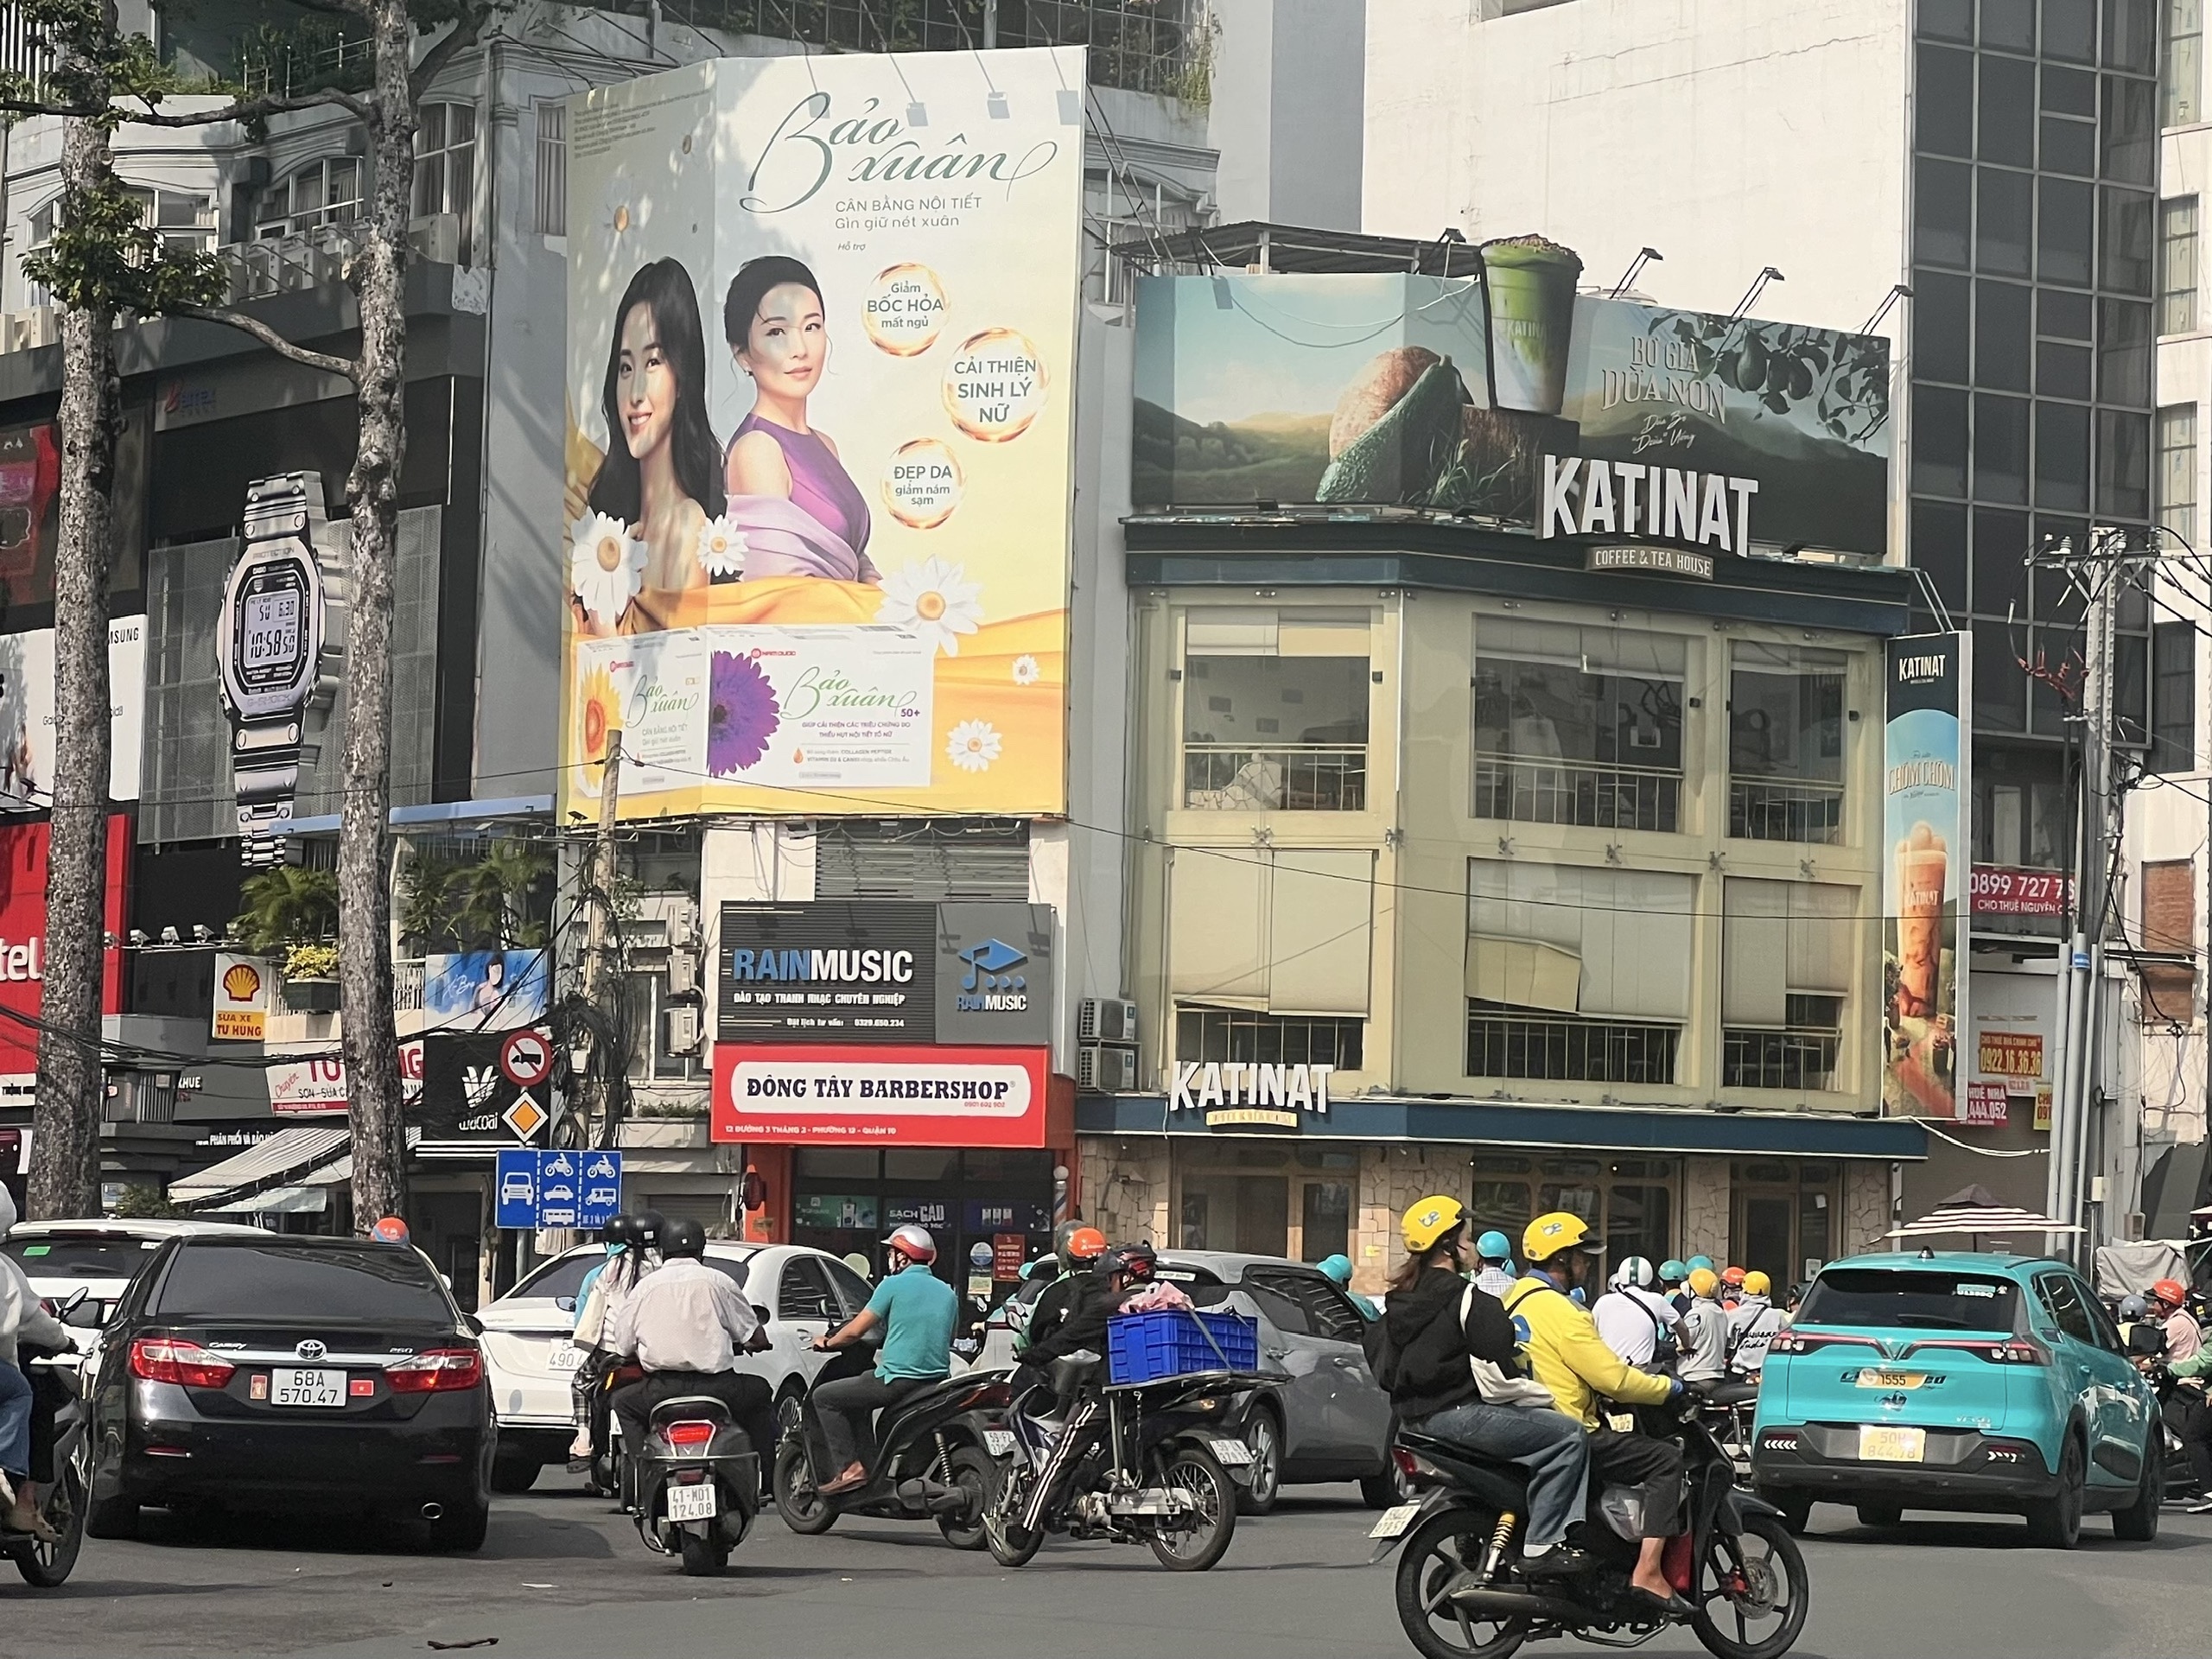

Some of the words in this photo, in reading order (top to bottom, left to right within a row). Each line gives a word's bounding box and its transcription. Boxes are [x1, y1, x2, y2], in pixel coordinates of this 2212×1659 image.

[739, 92, 905, 213] Bảo
[848, 132, 1058, 202] xuân
[835, 198, 868, 213] CÂN
[872, 195, 914, 213] BẰNG
[919, 195, 945, 214] NỘI
[950, 193, 982, 210] TIẾT
[835, 217, 860, 230] Gìn
[865, 216, 888, 232] giữ
[892, 215, 916, 229] nét
[921, 215, 959, 228] xuân
[891, 280, 921, 294] Giảm
[868, 295, 903, 313] BỐC
[907, 293, 944, 312] HỎA
[881, 316, 904, 328] mất
[906, 315, 929, 329] ngủ
[954, 356, 982, 374] CẢI
[987, 356, 1037, 376] THIỆN
[957, 382, 1004, 398] SINH
[1010, 377, 1033, 397] LÝ
[1666, 376, 1726, 424] NON
[979, 403, 1010, 423] NỮ
[893, 465, 926, 483] ĐẸP
[931, 465, 952, 479] DA
[895, 480, 923, 496] giảm
[925, 482, 950, 495] nám
[911, 496, 934, 507] sạm
[1541, 454, 1759, 558] KATINAT
[1595, 549, 1636, 566] COFFEE
[1639, 550, 1649, 565] &
[1651, 550, 1672, 569] TEA
[1677, 553, 1711, 577] HOUSE
[251, 629, 282, 658] 10:58
[1898, 654, 1946, 682] KATINAT
[626, 674, 663, 728] Bảo
[779, 666, 850, 720] Bảo
[826, 686, 917, 718] xuân
[901, 709, 921, 717] 50+
[1970, 872, 2012, 895] 0899
[2018, 875, 2050, 898] 727
[1977, 899, 1998, 910] CHO
[1999, 899, 2019, 912] THUÊ
[734, 949, 913, 982] RAINMUSIC
[734, 991, 752, 1004] ĐÀO
[754, 993, 772, 1005] TẠO
[774, 993, 804, 1004] THANH
[835, 992, 870, 1005] CHUYÊN
[956, 994, 1027, 1012] RAINMUSIC
[1980, 1047, 2042, 1075] 0922.16.36.36
[747, 1074, 807, 1098] ĐÔNG
[814, 1075, 854, 1099] TÂY
[860, 1079, 1009, 1100] BARBERSHOP
[1169, 1061, 1334, 1114] KATINAT
[772, 1125, 800, 1134] THÁNG
[862, 1126, 887, 1136] QUẬN
[889, 1210, 918, 1219] SẠCH
[1418, 1211, 1440, 1227] be
[1541, 1222, 1562, 1236] be
[294, 1370, 325, 1387] 68A
[1880, 1374, 1906, 1386] 1555
[280, 1388, 338, 1404] 570.47
[672, 1502, 713, 1518] 124.08
